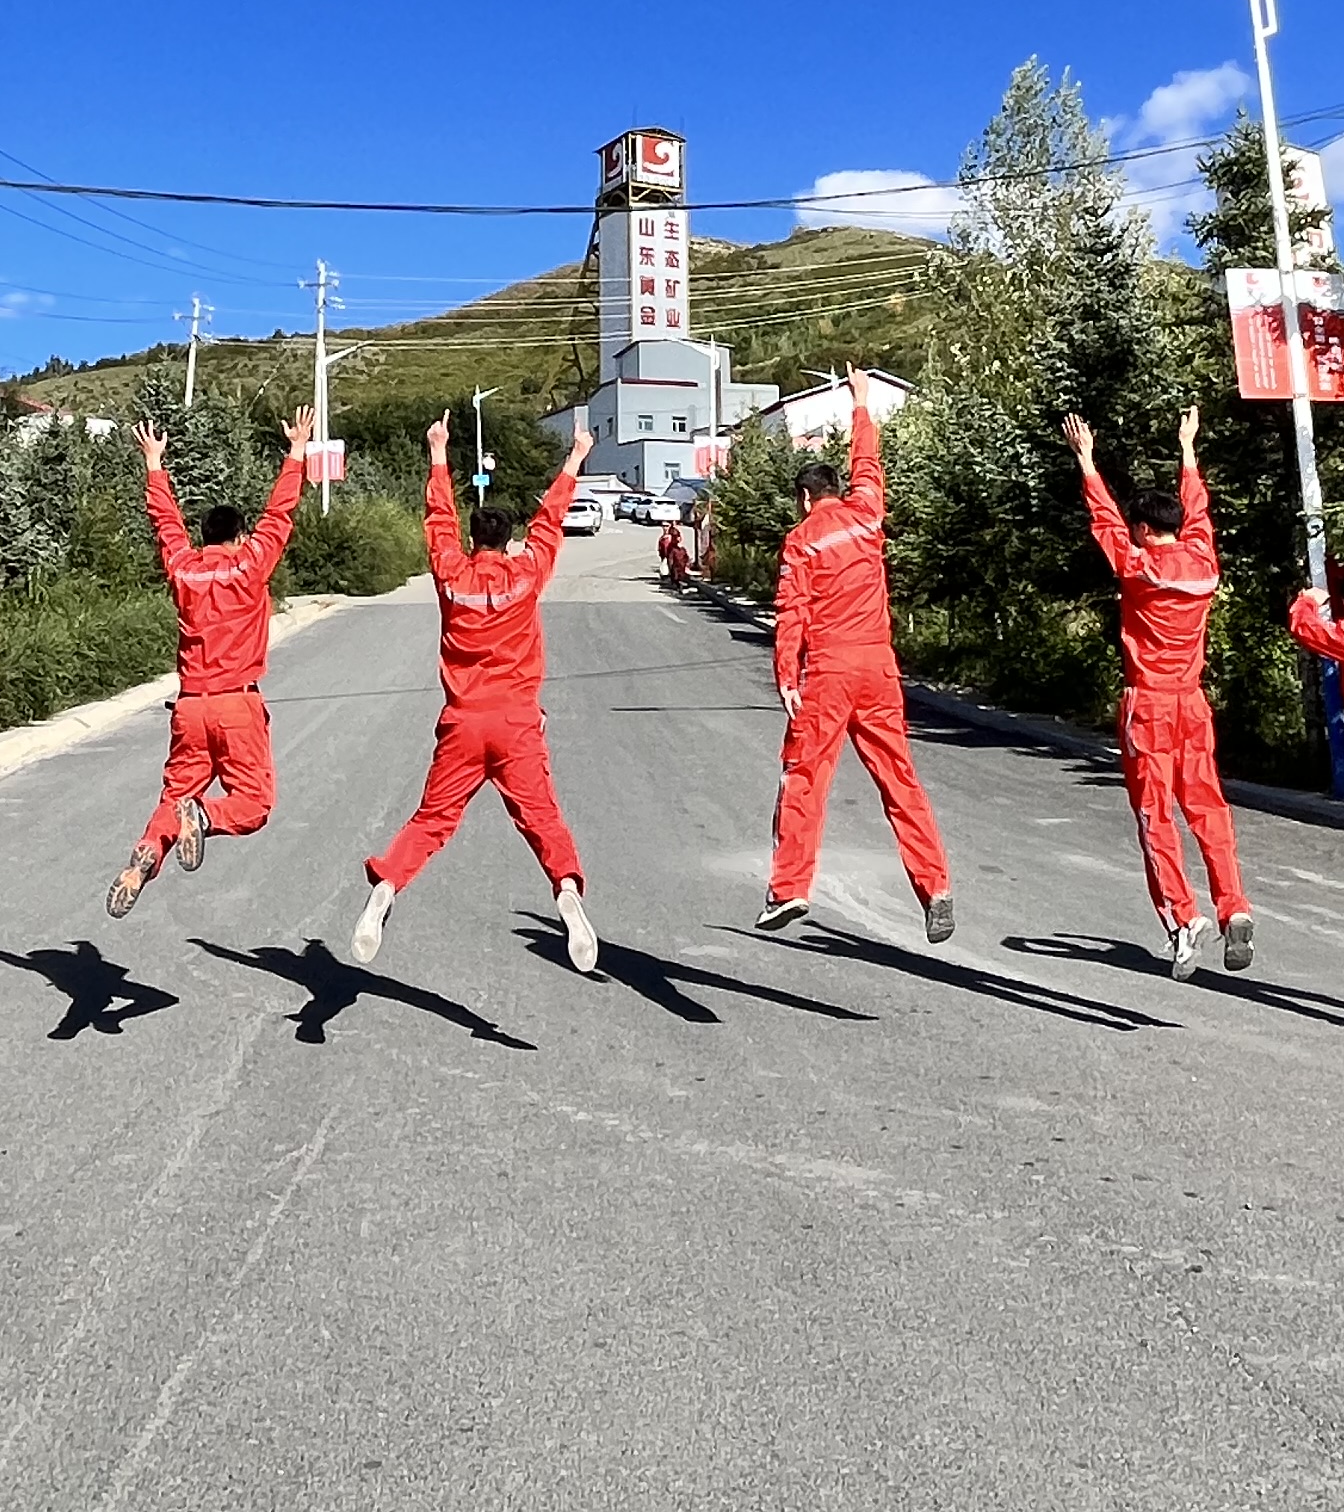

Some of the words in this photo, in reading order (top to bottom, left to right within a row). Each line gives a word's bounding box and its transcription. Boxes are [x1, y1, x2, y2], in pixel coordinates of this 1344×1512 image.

[639, 217, 656, 326] 山东黄金
[663, 220, 681, 329] 生态矿业
